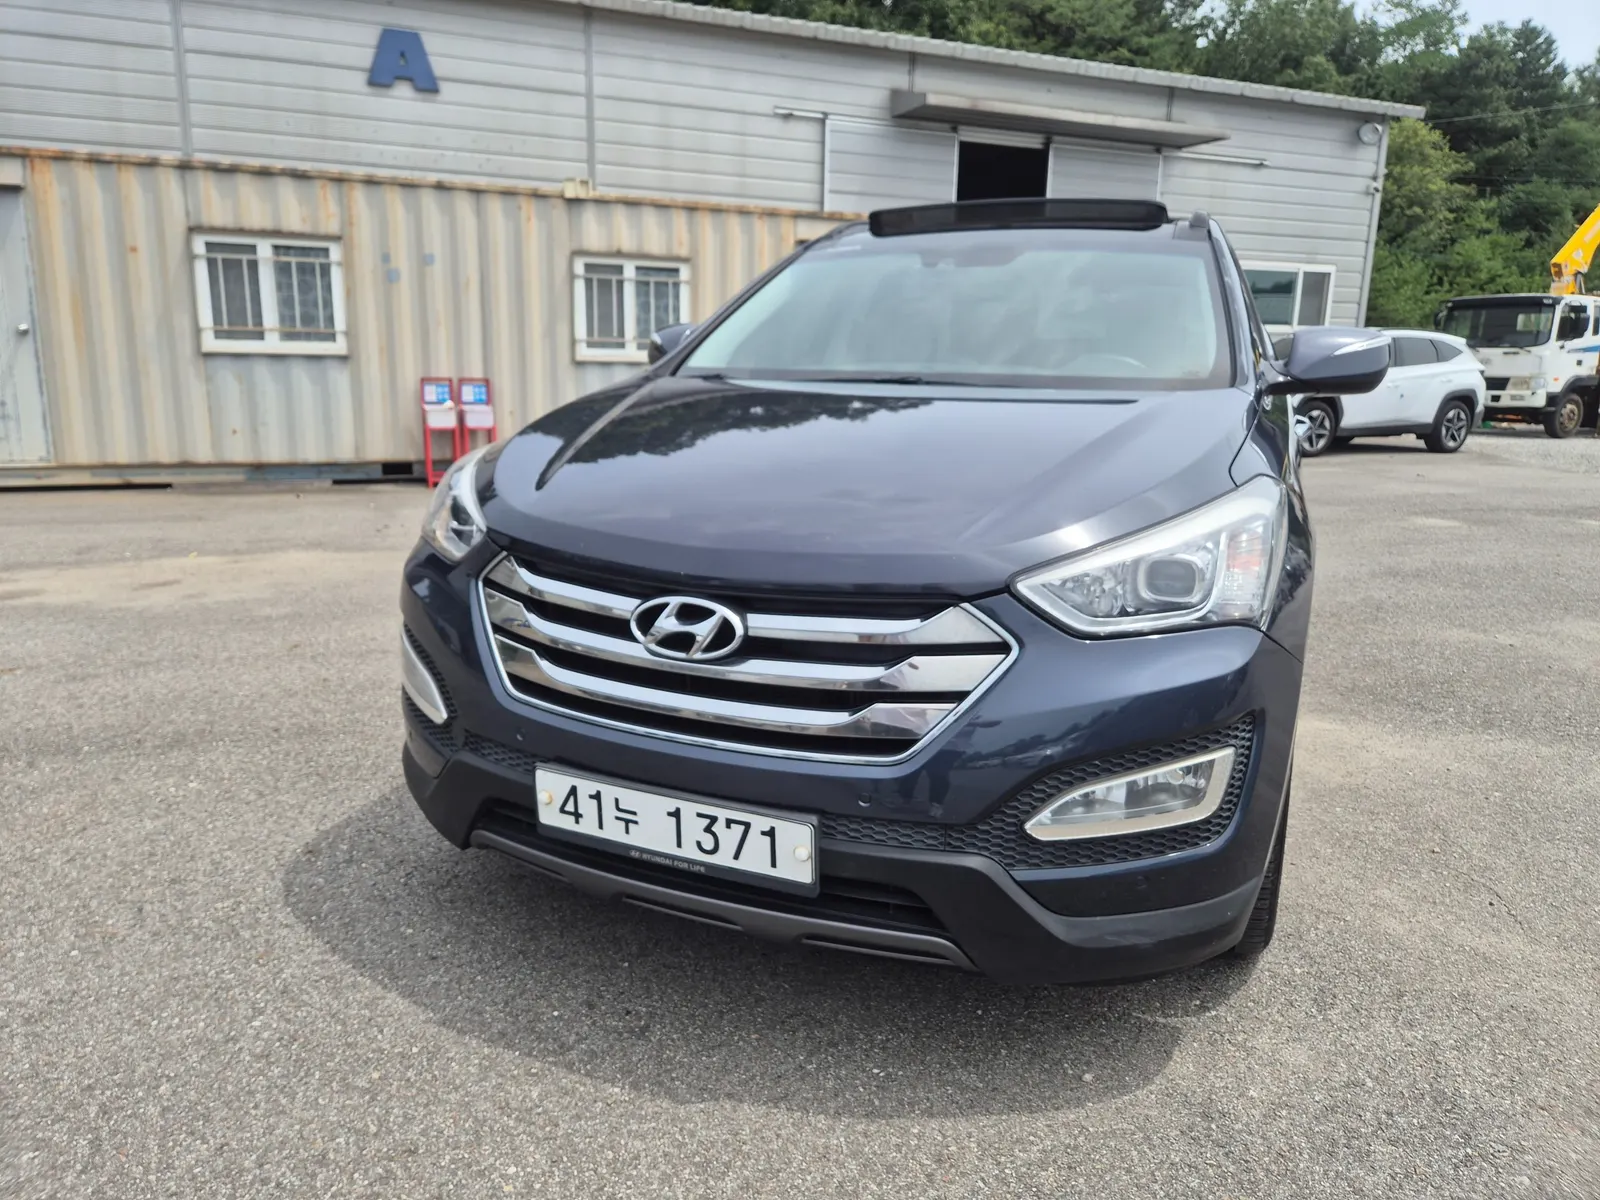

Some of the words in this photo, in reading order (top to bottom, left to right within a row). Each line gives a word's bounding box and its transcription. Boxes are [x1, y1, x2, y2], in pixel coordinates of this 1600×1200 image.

[367, 27, 439, 93] A
[558, 784, 639, 835] 41누
[666, 806, 778, 869] 1371
[642, 853, 673, 865] HYUNDAI
[673, 860, 689, 869] FOR
